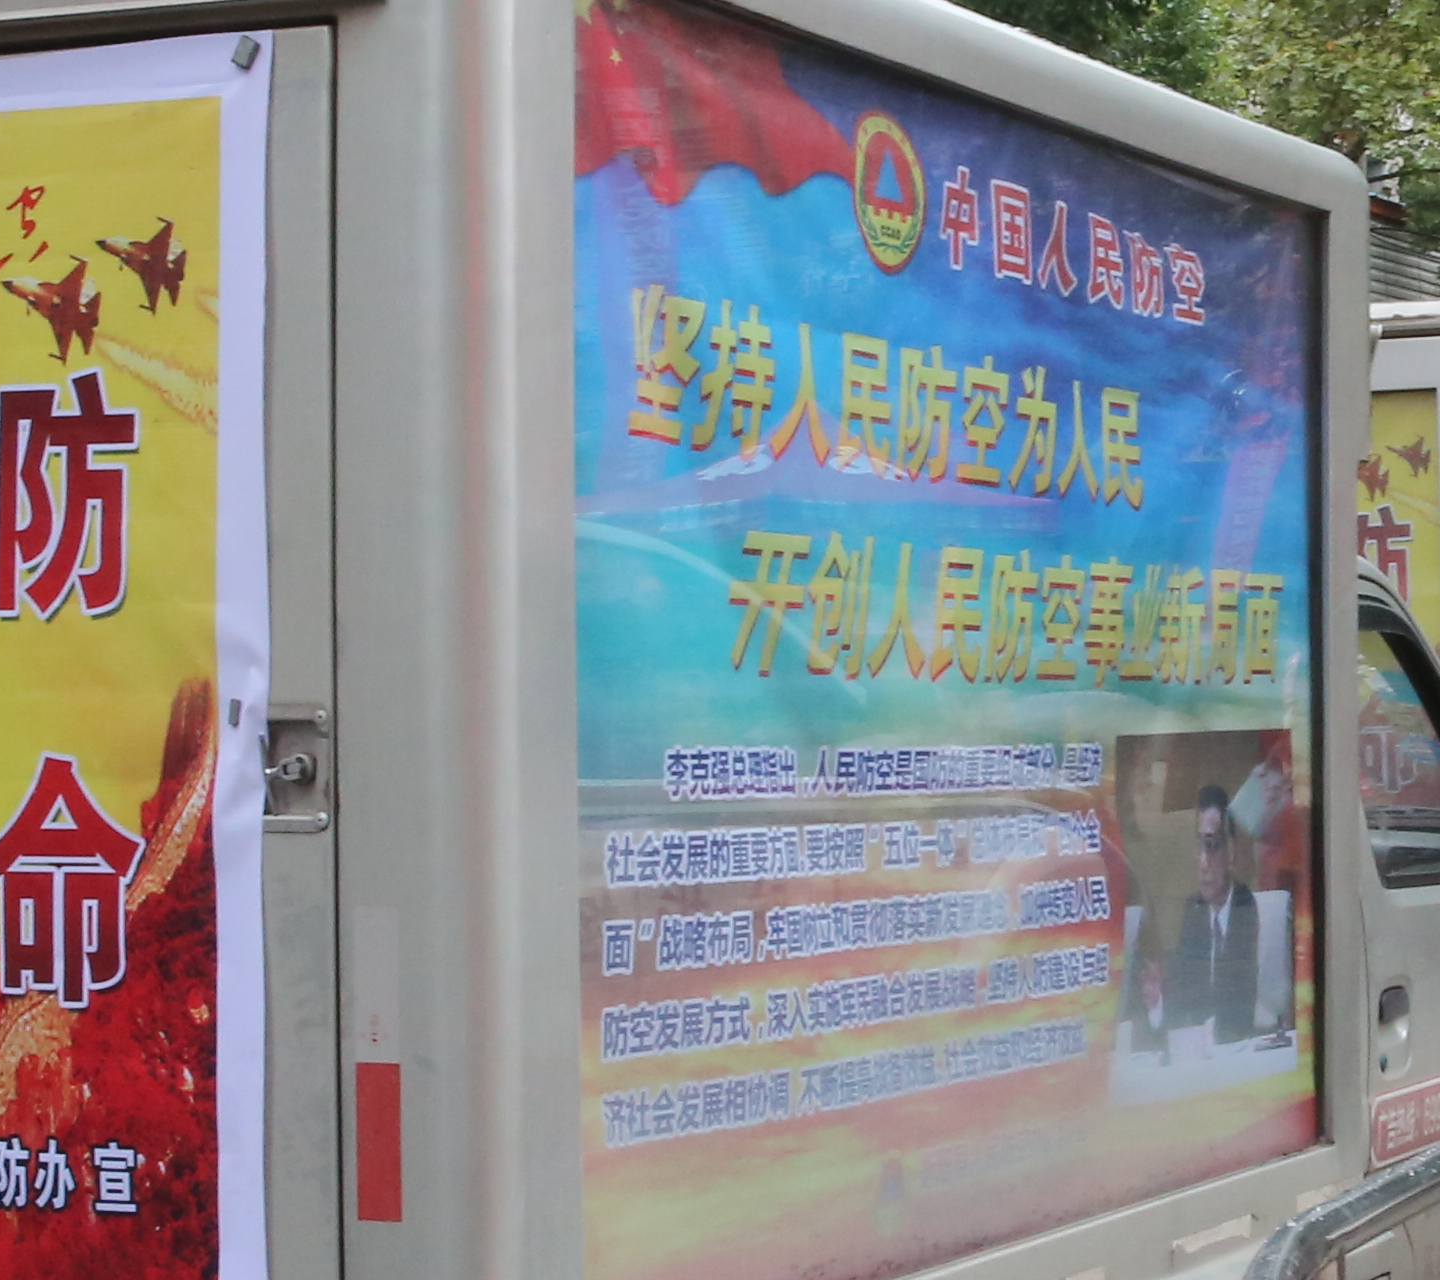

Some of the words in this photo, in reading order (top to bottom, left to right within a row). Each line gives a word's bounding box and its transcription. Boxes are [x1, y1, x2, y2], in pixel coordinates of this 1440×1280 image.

[940, 165, 1206, 326] 中国人民防空
[628, 284, 1146, 512] 坚持人民防空为人民
[729, 529, 1285, 686] 开创人民防空事业新局面
[93, 1142, 138, 1214] 宣
